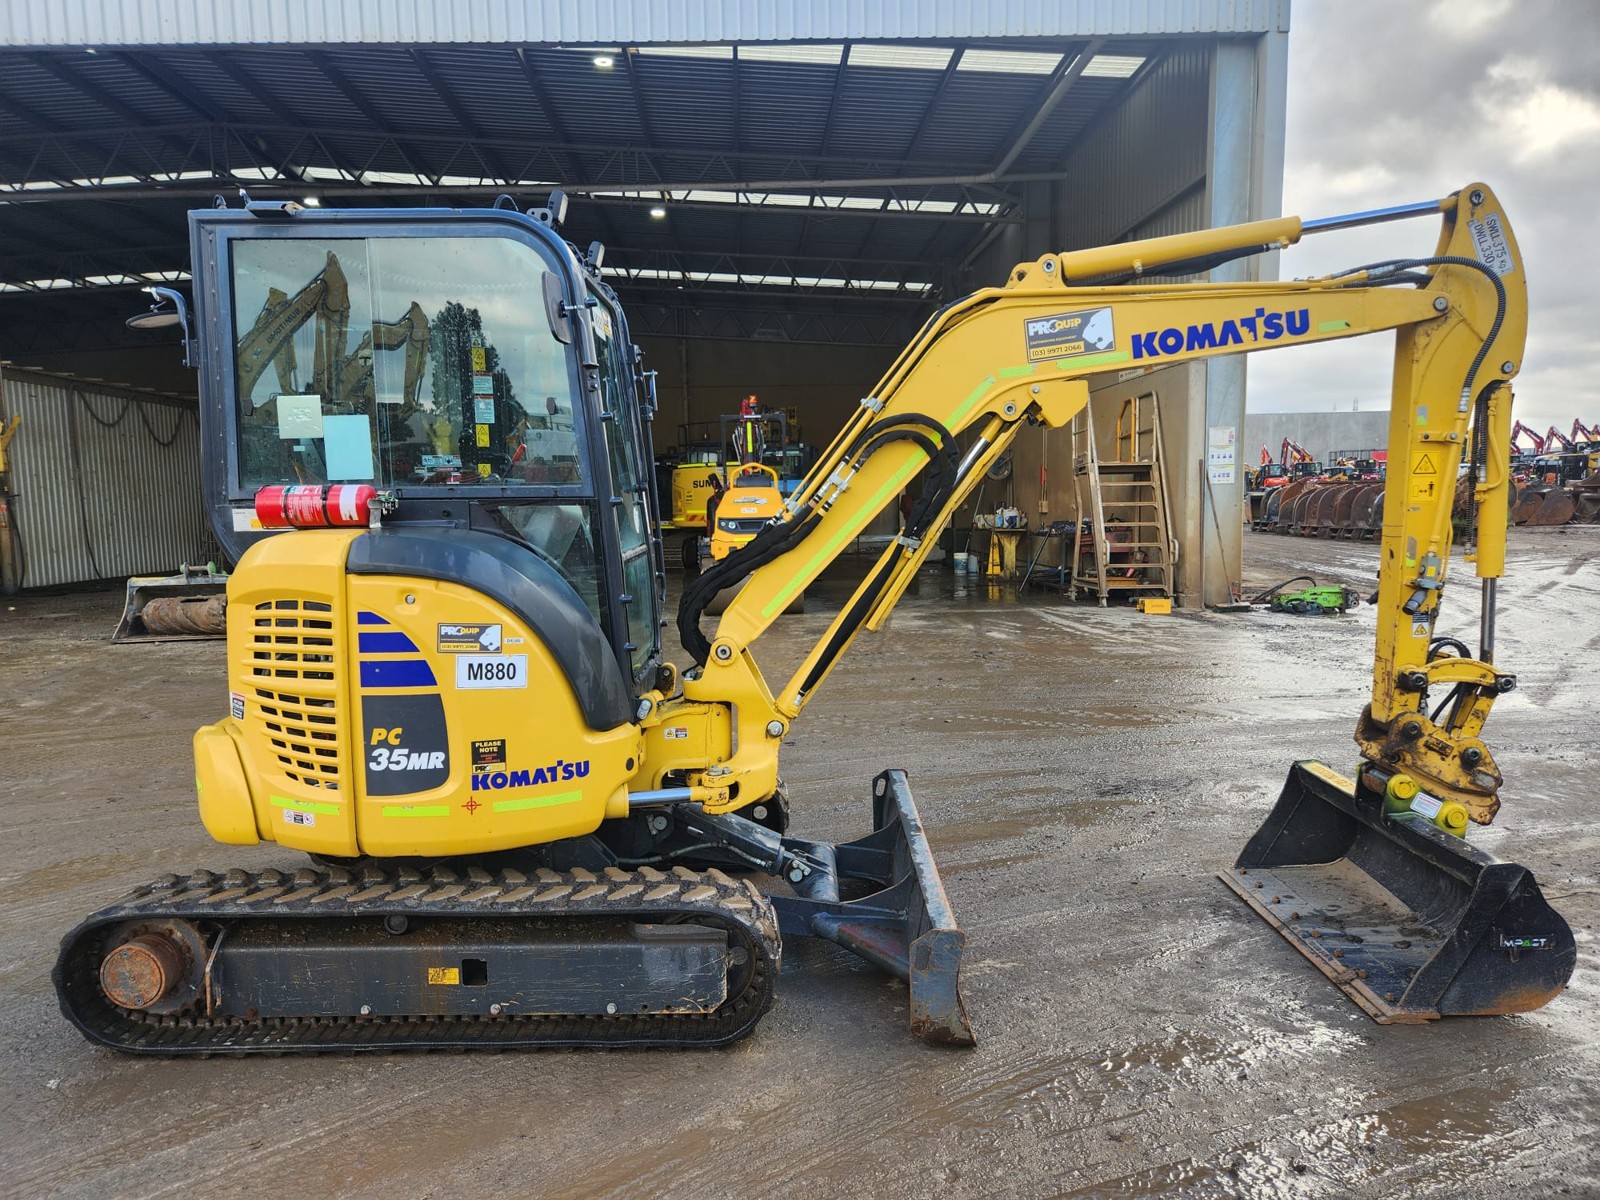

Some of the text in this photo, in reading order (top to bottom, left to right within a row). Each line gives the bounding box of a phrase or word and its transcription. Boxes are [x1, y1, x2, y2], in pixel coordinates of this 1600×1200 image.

[1474, 223, 1488, 247] DWLL
[1481, 245, 1495, 264] 330
[1486, 218, 1500, 241] SWLL
[1493, 242, 1507, 259] 375
[1131, 307, 1310, 360] KOMATSU
[1032, 344, 1082, 358] (03) 9971 2066
[468, 662, 516, 681] M880
[370, 727, 403, 746] PC
[475, 740, 502, 748] PLEASE
[369, 747, 445, 771] 35MR
[472, 759, 590, 791] KOMATSU
